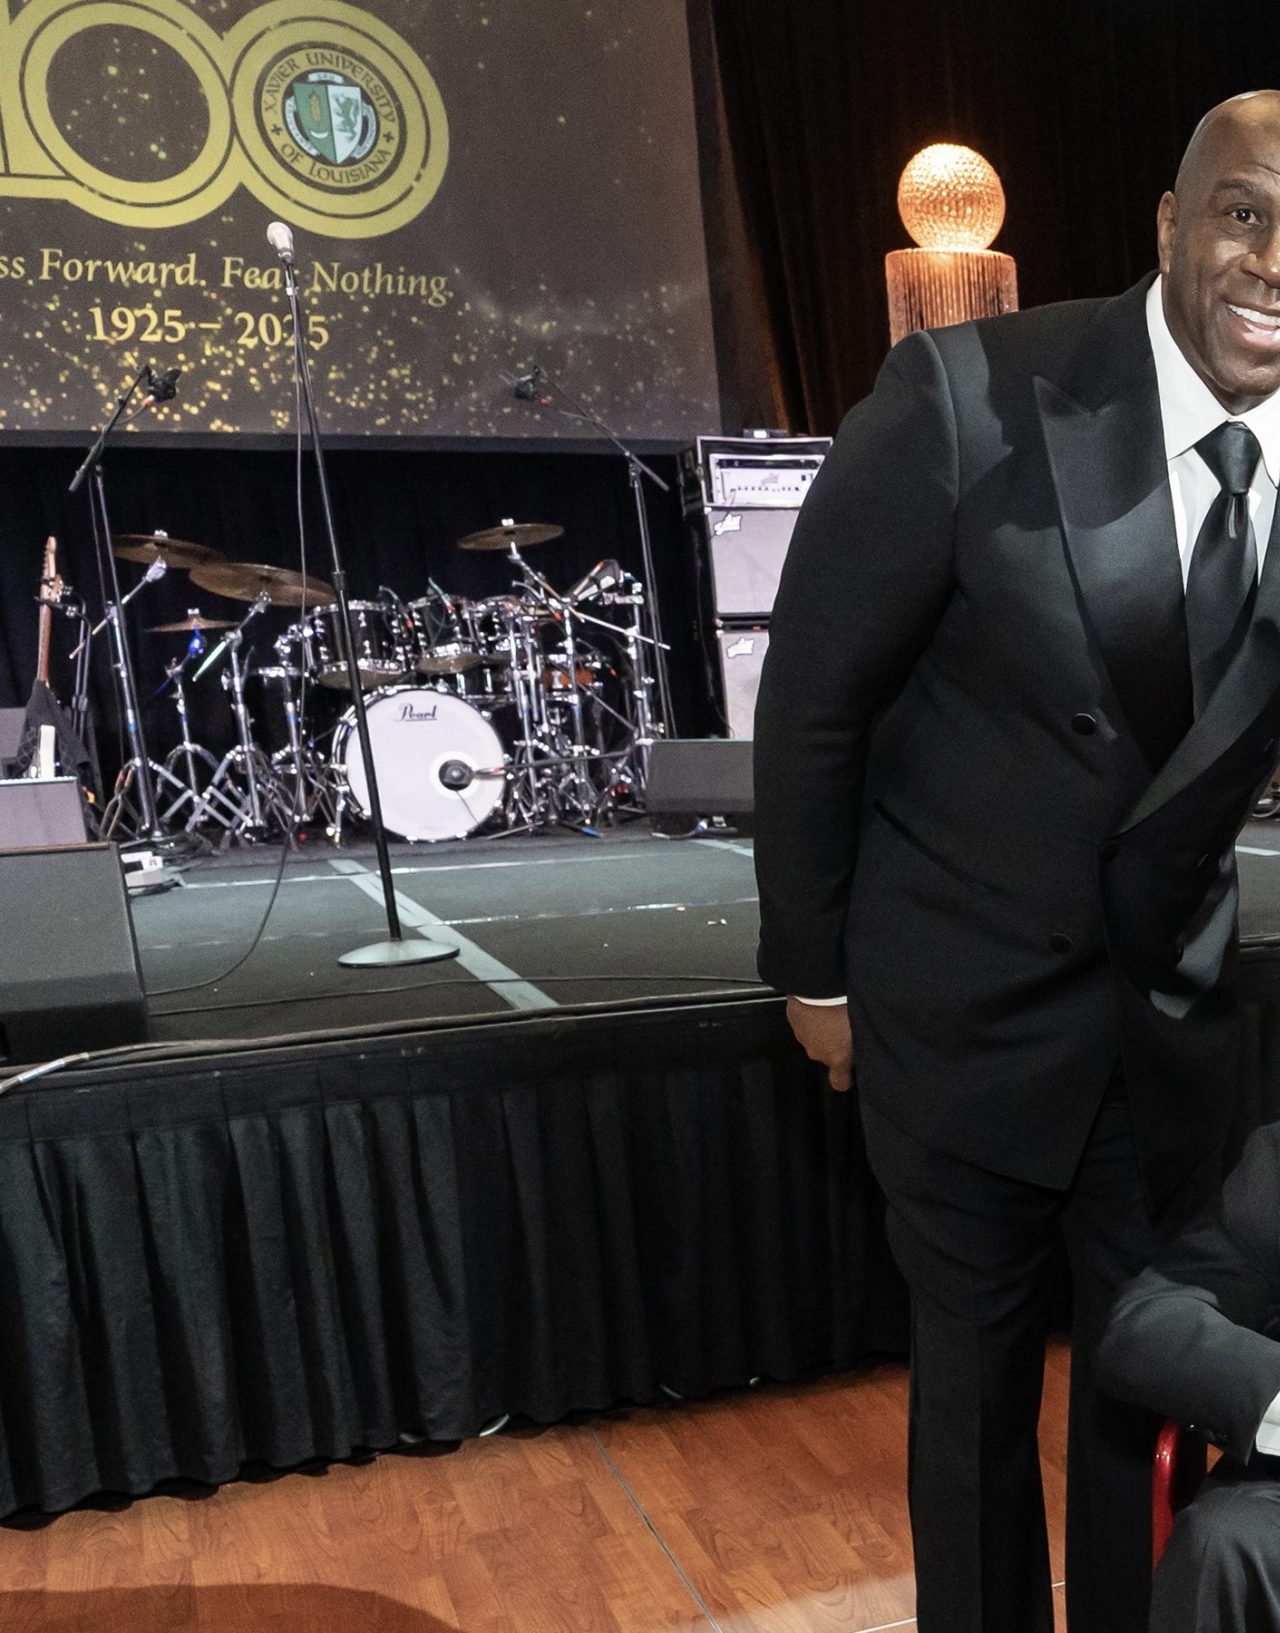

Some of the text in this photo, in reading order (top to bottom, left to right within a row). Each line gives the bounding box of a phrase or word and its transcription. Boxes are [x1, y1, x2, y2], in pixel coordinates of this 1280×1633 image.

[264, 51, 397, 124] XAVIER UNIVERSITY
[280, 143, 392, 184] OF LOUISIANA
[38, 247, 207, 287] Forward.
[220, 256, 298, 290] Fea
[394, 703, 437, 721] Pearl
